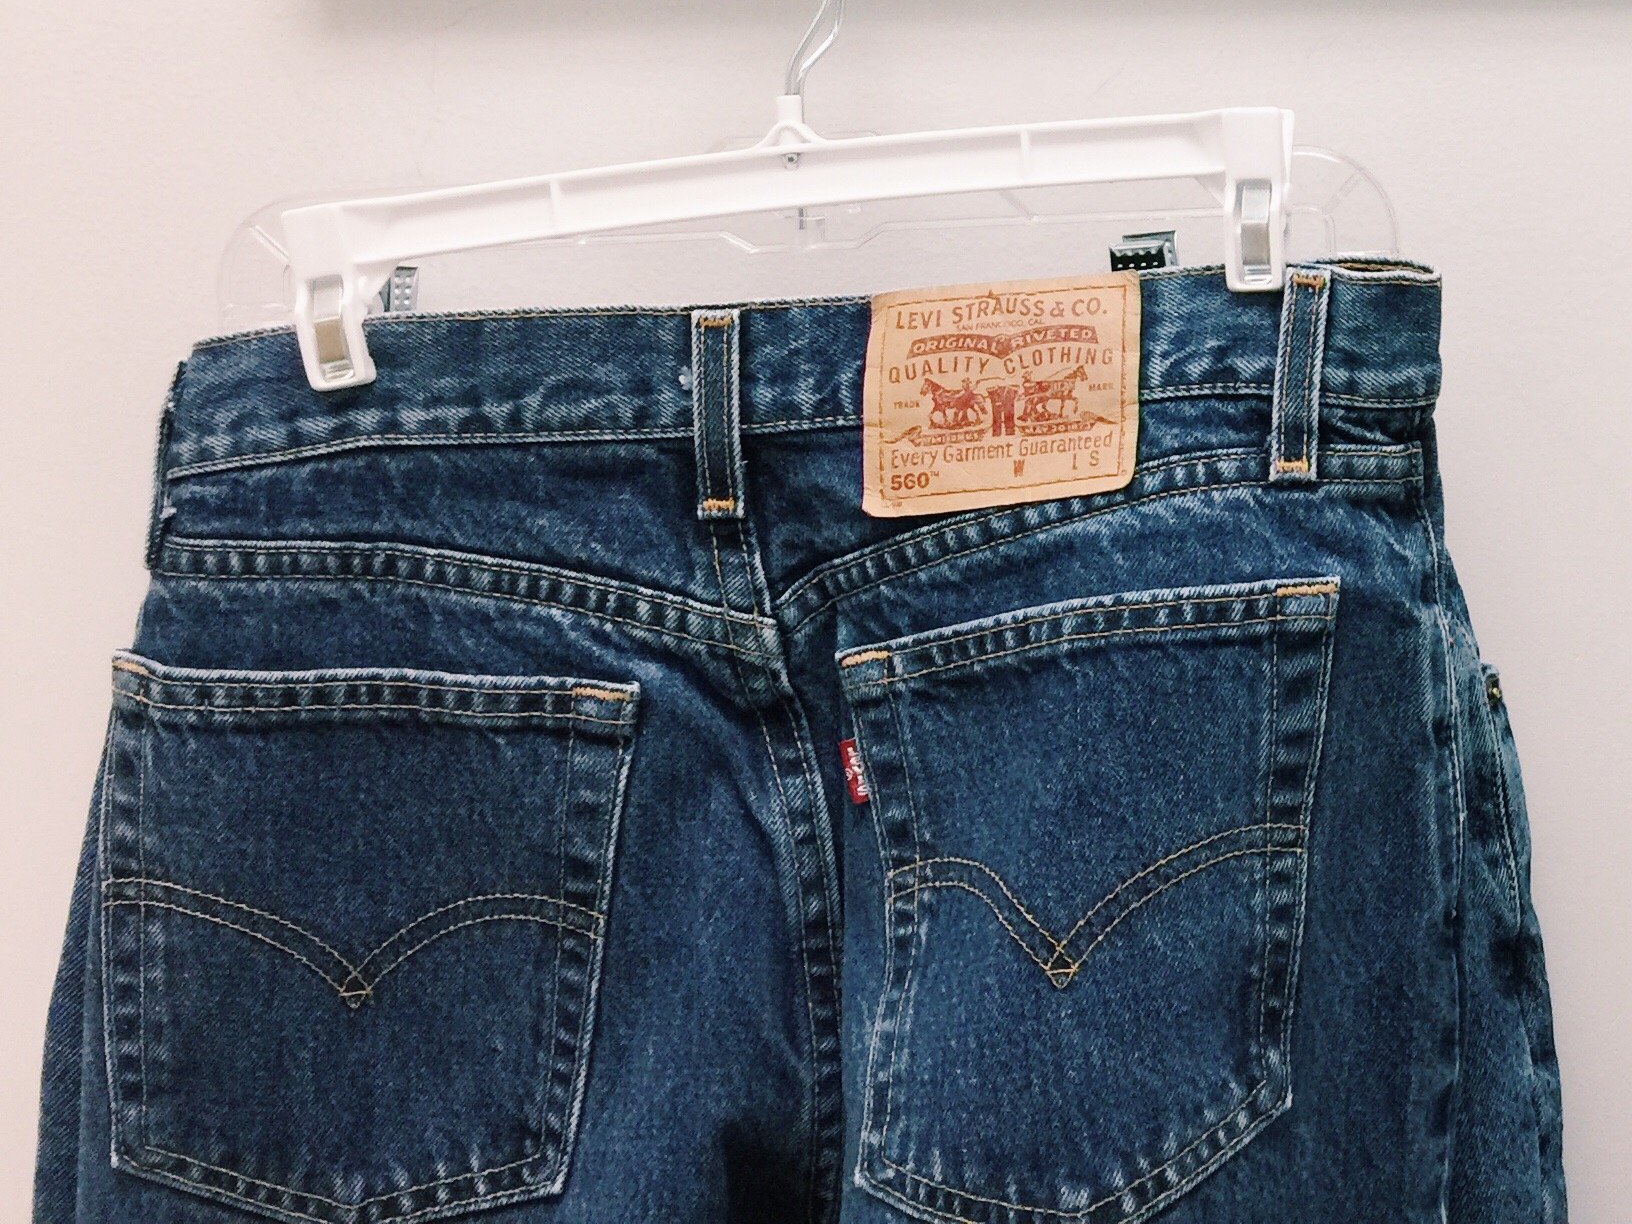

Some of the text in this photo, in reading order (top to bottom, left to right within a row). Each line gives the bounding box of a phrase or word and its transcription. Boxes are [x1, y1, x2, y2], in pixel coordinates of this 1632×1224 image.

[895, 297, 1107, 330] LEVI STRAUSS & CO.
[912, 328, 1093, 355] ORIGINAL RIVETED
[888, 345, 1114, 383] QUALITY CLOTHING
[891, 430, 1113, 468] Every Garment Guaranteed
[1013, 459, 1025, 477] W
[1089, 450, 1099, 466] S
